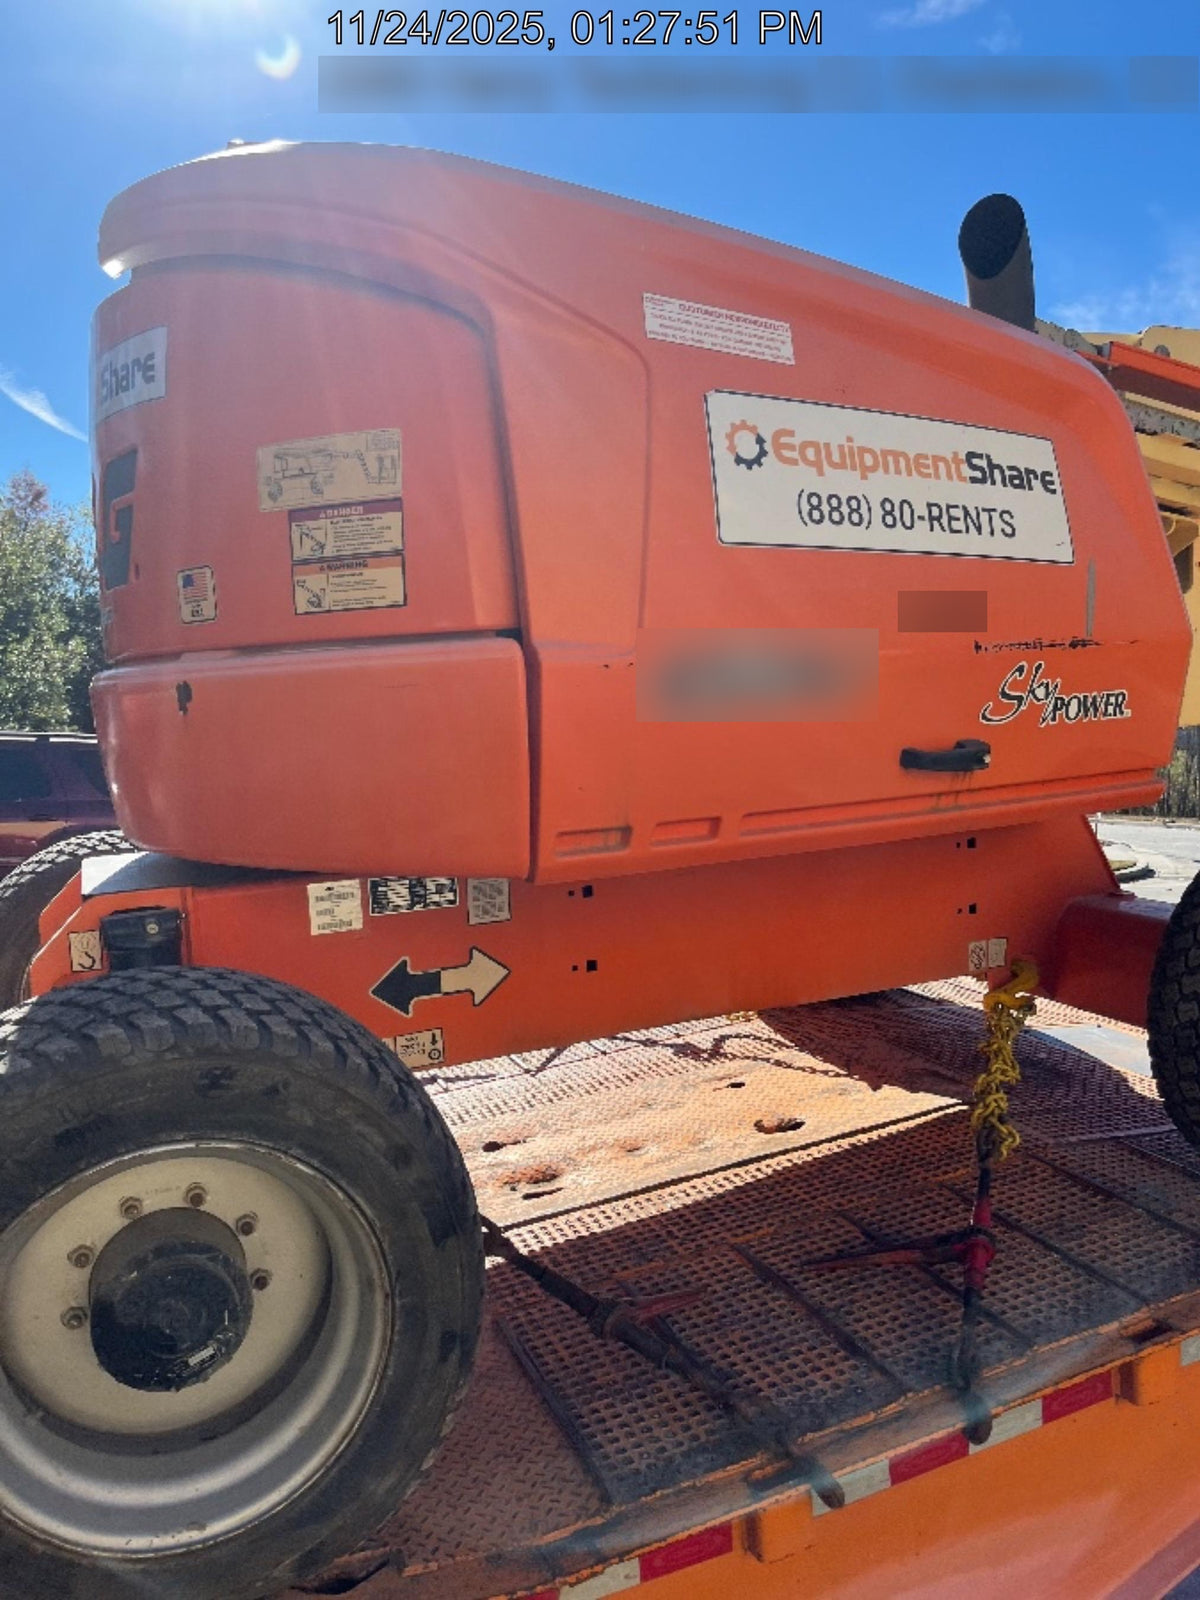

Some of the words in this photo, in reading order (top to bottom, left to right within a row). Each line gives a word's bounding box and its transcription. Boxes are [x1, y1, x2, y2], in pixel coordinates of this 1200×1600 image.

[770, 427, 1057, 495] EquipmentShare
[797, 488, 872, 531] (888)
[880, 497, 1017, 539] 80-RENTS
[1049, 690, 1131, 723] POWER
